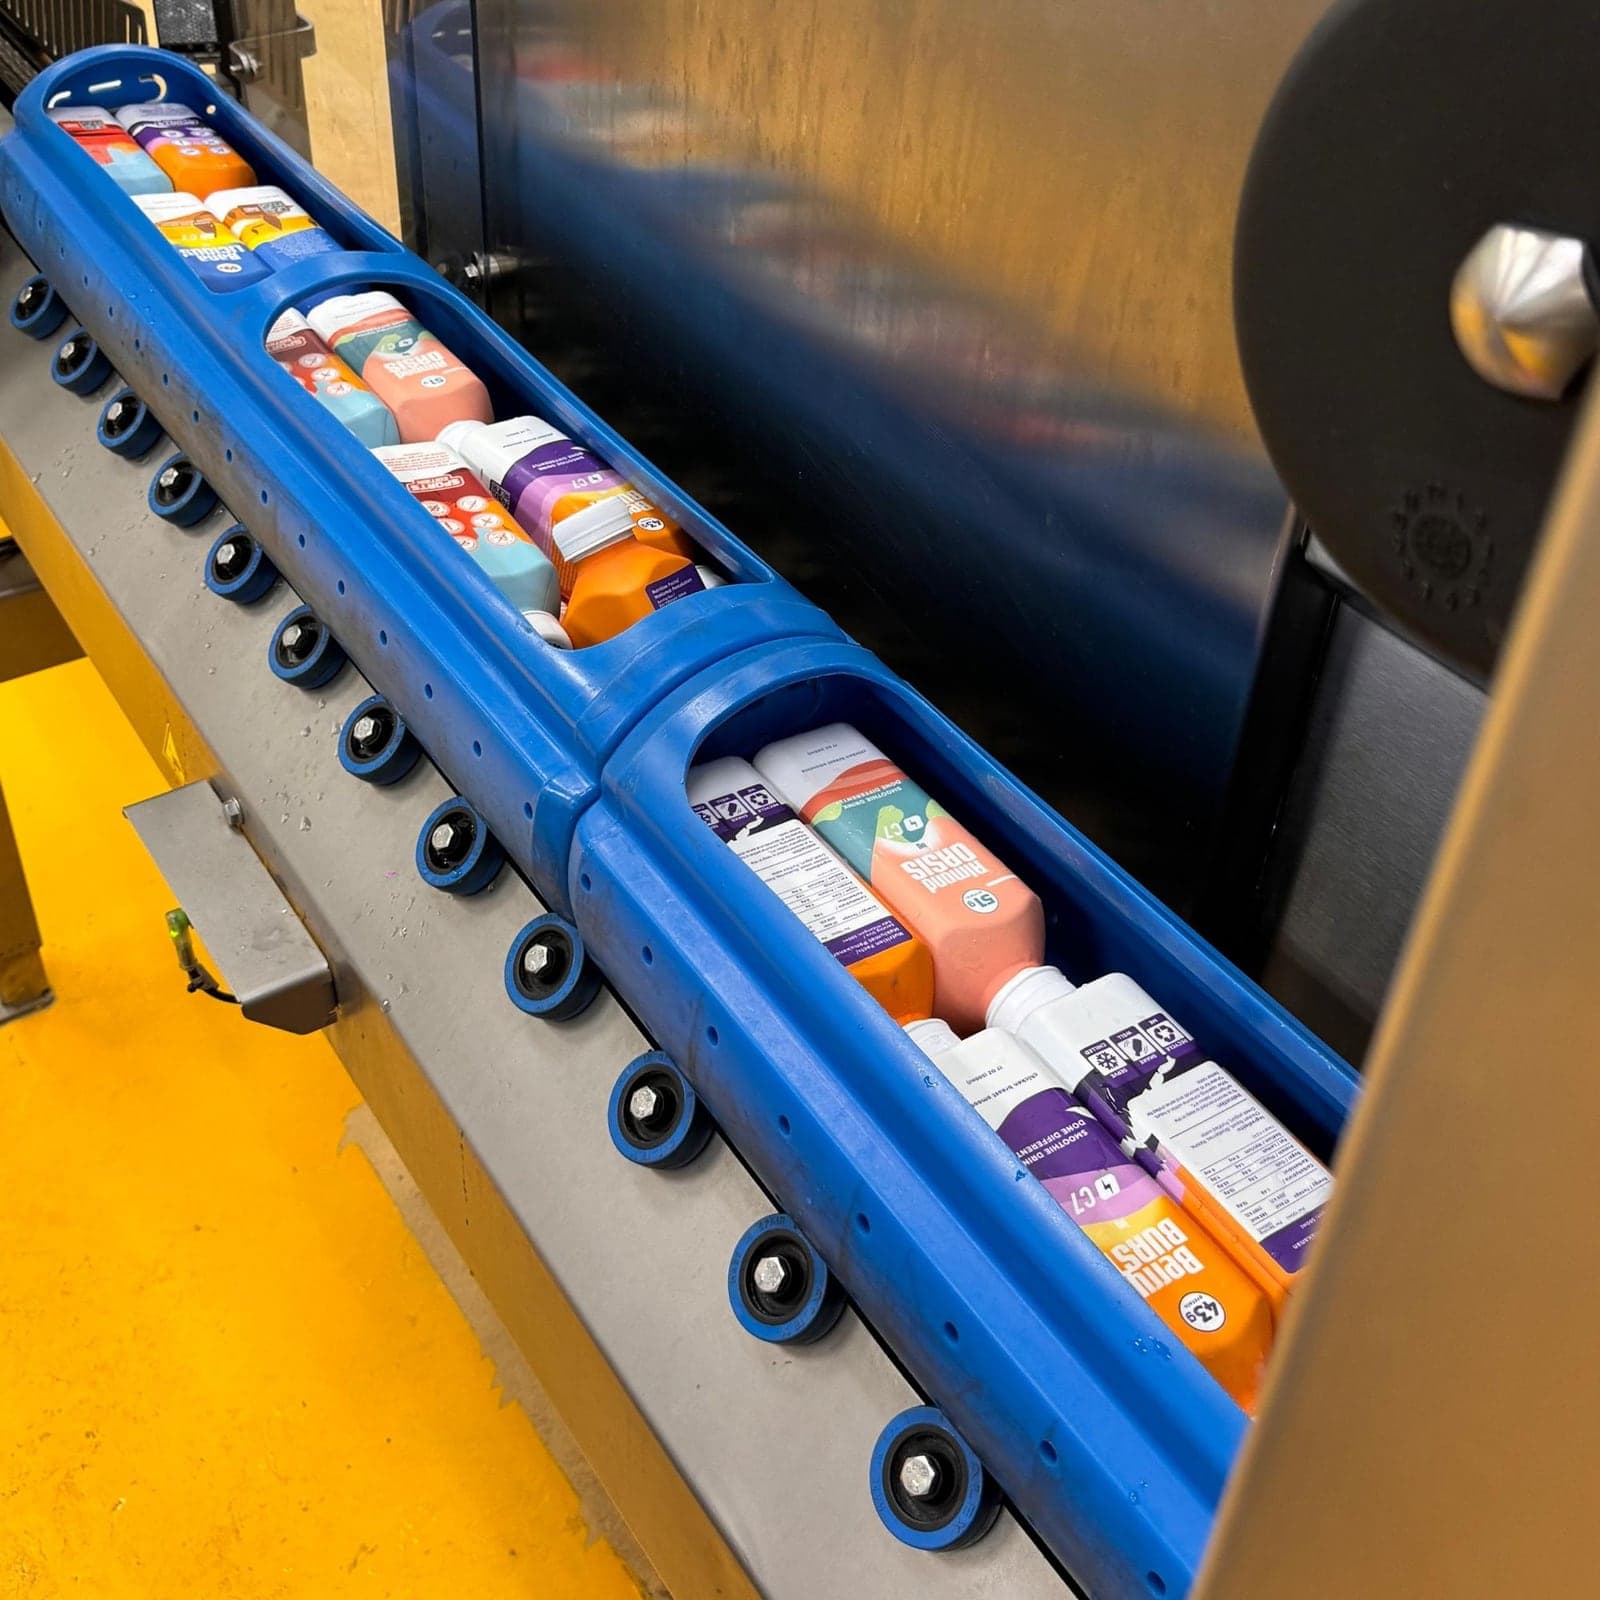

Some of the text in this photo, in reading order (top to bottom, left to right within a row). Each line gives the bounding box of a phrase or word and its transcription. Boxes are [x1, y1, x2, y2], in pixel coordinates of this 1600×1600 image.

[409, 477, 460, 490] SPORTS
[863, 785, 903, 802] SMOOTHIE
[880, 821, 905, 841] C7
[897, 840, 978, 882] OASIS
[918, 858, 990, 895] Almond
[965, 892, 997, 908] 51g
[1115, 1029, 1133, 1040] WELL
[1083, 1041, 1107, 1056] CHILLED
[1164, 1037, 1188, 1052] RECYCLE
[1138, 1052, 1158, 1065] SHAKE
[1109, 1066, 1129, 1079] SERVE
[969, 1094, 992, 1107] smoo
[1013, 1117, 1087, 1159] DONE DIFFERENT
[1019, 1127, 1090, 1166] SMOOTHIE DRIN
[1069, 1184, 1099, 1216] C7
[1120, 1242, 1206, 1299] Berry
[1183, 1301, 1218, 1323] 43g
